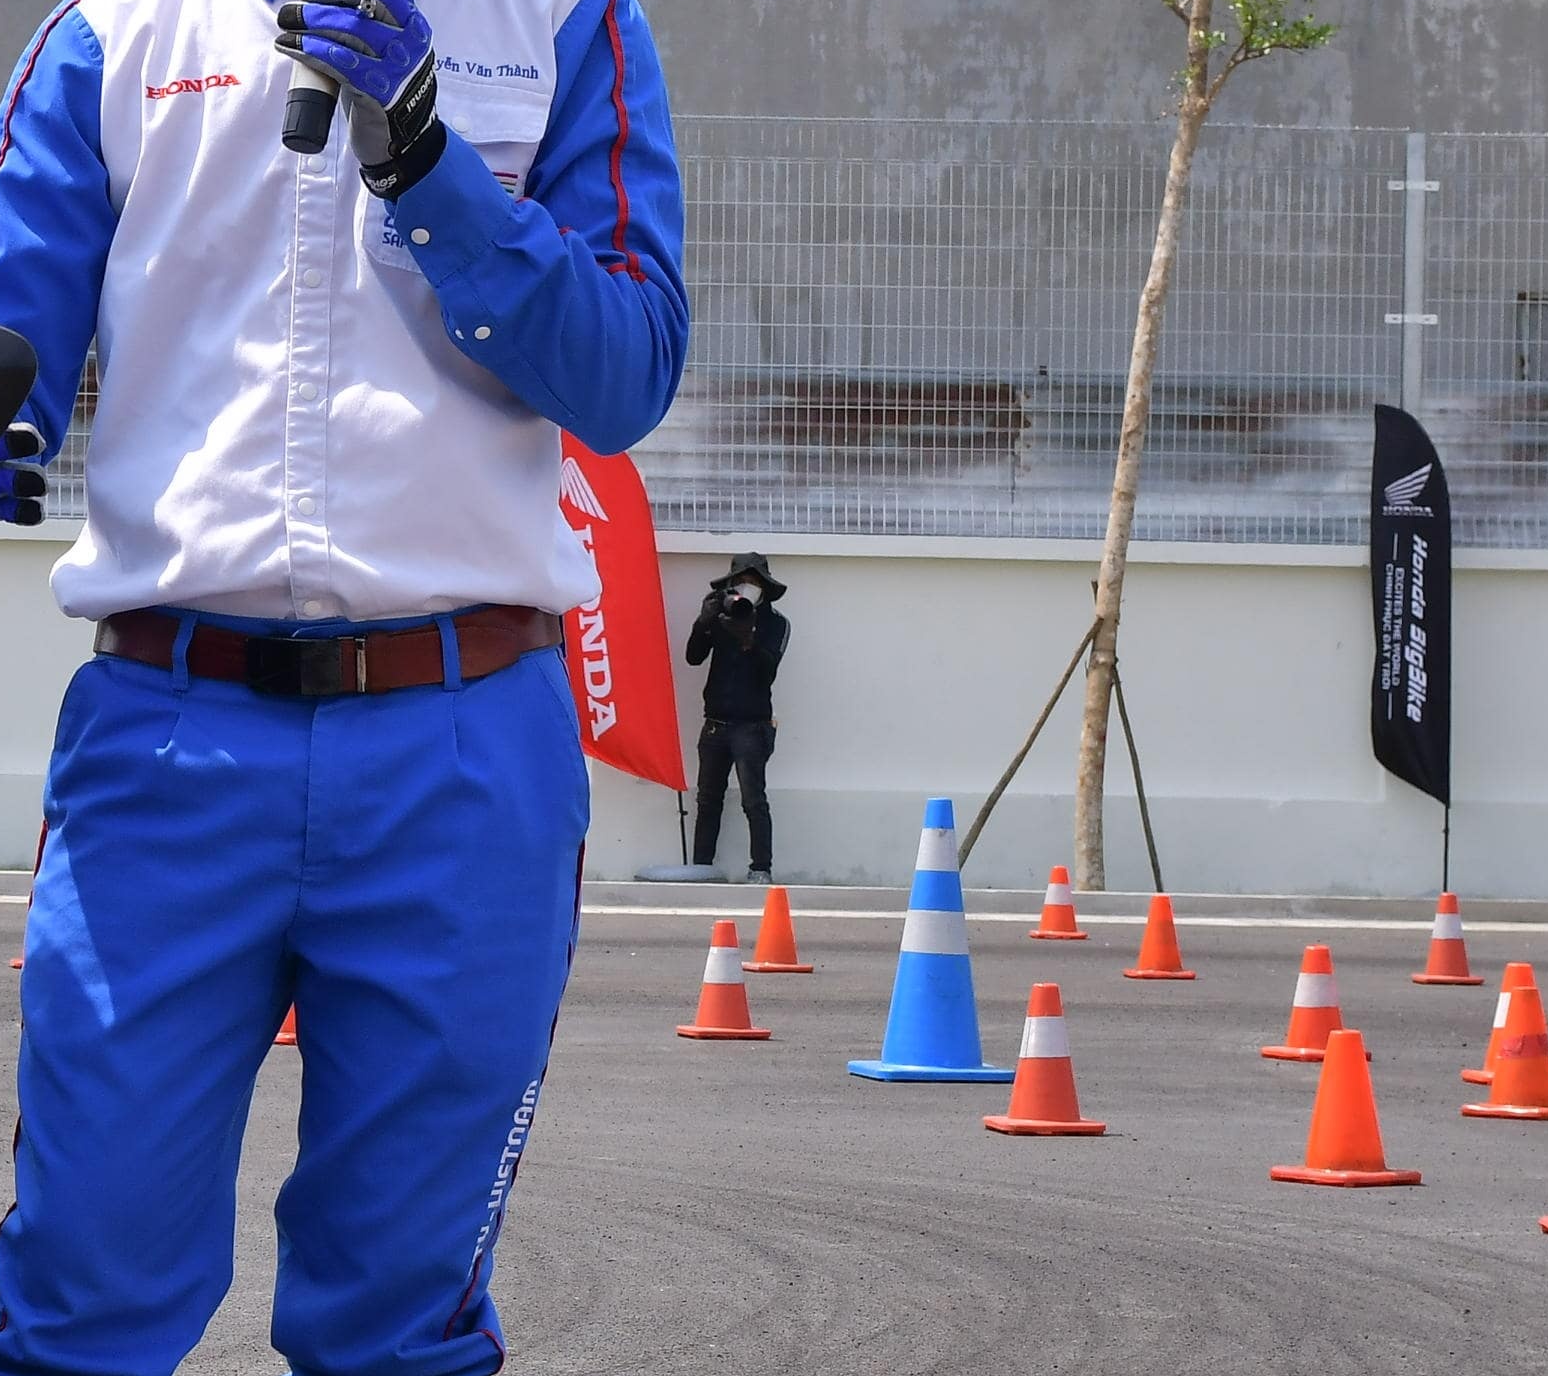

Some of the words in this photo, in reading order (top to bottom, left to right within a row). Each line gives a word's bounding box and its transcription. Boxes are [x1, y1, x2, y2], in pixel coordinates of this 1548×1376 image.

[146, 75, 241, 99] HONDA
[1411, 534, 1429, 620] Honda
[1392, 618, 1403, 640] THE
[1404, 624, 1428, 722] BigBike
